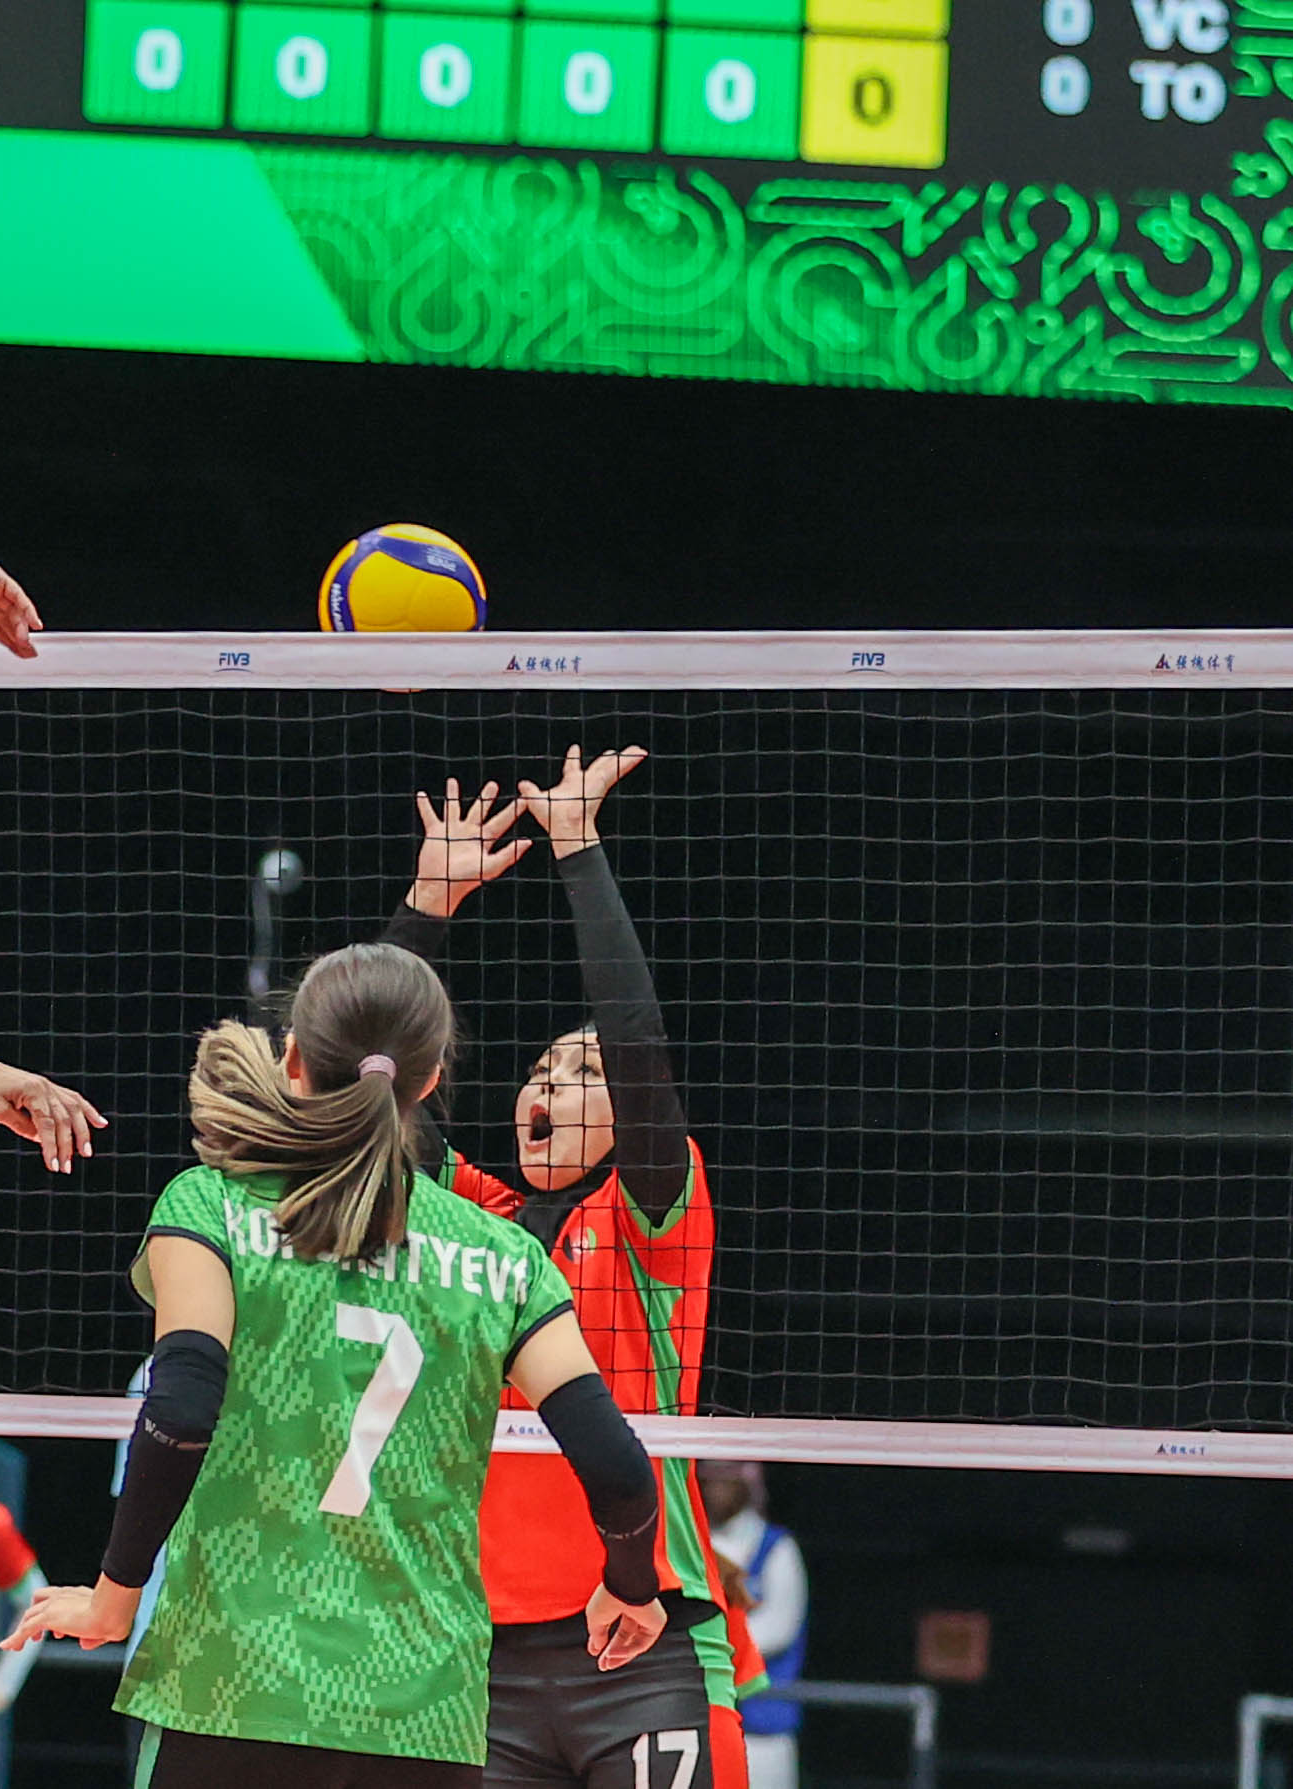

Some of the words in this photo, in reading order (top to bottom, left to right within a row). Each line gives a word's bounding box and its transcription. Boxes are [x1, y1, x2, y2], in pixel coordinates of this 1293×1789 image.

[1131, 0, 1229, 53] VC
[134, 28, 183, 91] 0
[276, 35, 329, 100] 0
[419, 43, 472, 108] 0
[564, 51, 613, 115] 0
[706, 59, 756, 123] 0
[851, 71, 893, 126] 0
[1040, 54, 1092, 116] 0
[1128, 59, 1228, 123] TO
[318, 1302, 424, 1517] 7
[632, 1730, 699, 1789] 17
